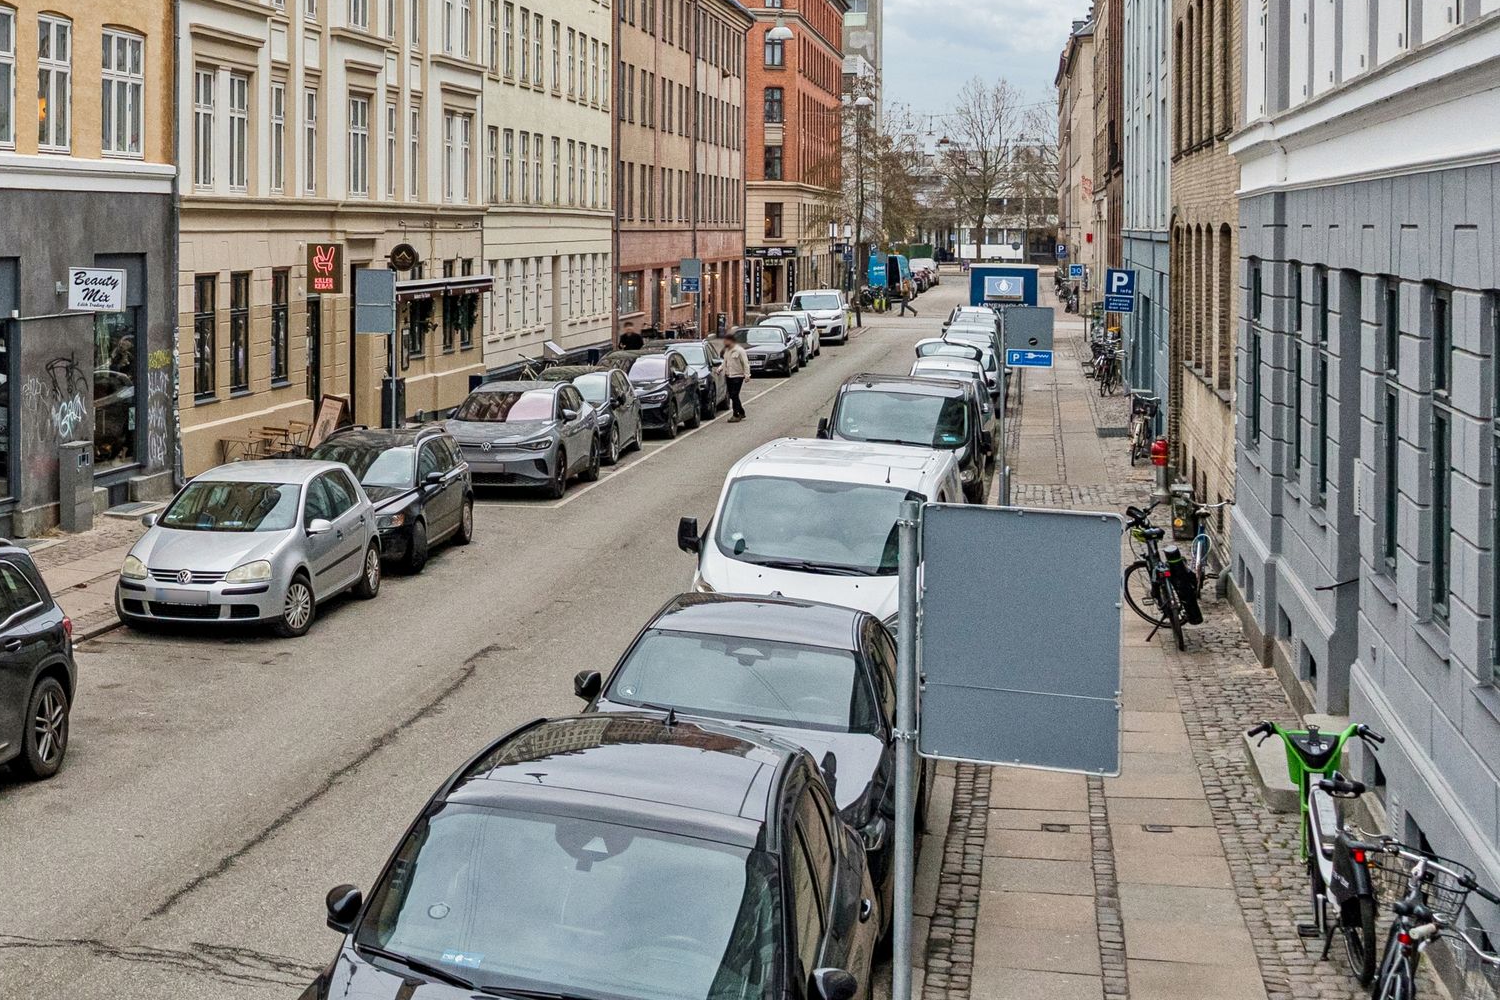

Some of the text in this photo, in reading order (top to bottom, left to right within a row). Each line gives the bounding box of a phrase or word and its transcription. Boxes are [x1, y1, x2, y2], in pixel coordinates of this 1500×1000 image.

[74, 271, 119, 290] Beauty
[1112, 272, 1129, 293] P
[82, 288, 110, 302] Mix
[1013, 353, 1020, 361] P
